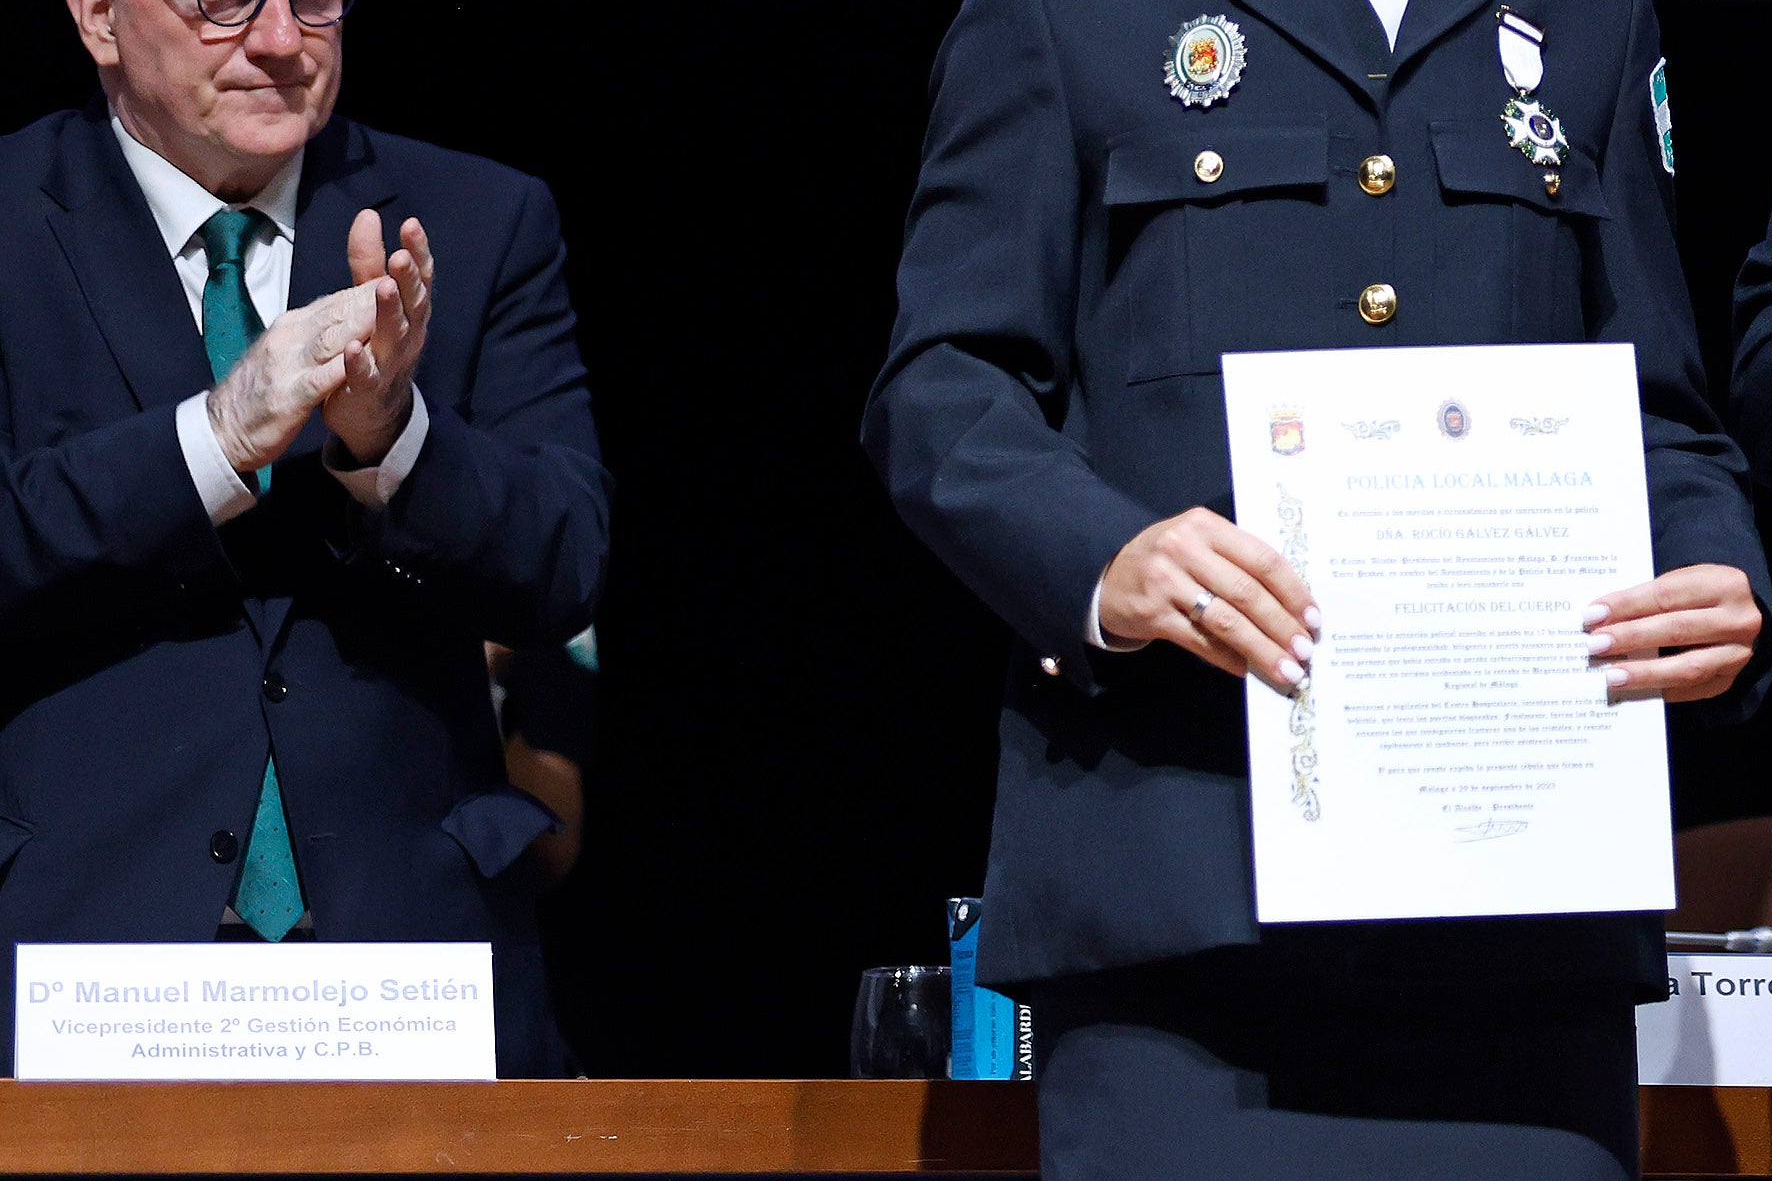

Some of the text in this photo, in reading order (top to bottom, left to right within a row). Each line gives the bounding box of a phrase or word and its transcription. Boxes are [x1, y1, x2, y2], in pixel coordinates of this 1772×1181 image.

[1432, 473, 1499, 489] LOCAL
[1489, 601, 1516, 613] DEL
[1517, 600, 1572, 613] CUERPO
[75, 980, 190, 1004] Manuel
[202, 979, 368, 1007] Marmolejo
[379, 978, 479, 1003] Setién
[52, 1018, 213, 1037] Vicepresidente
[247, 1017, 331, 1034] Gestión
[338, 1016, 457, 1033] Económica
[131, 1041, 380, 1061] Administrativa y C.P.B.
